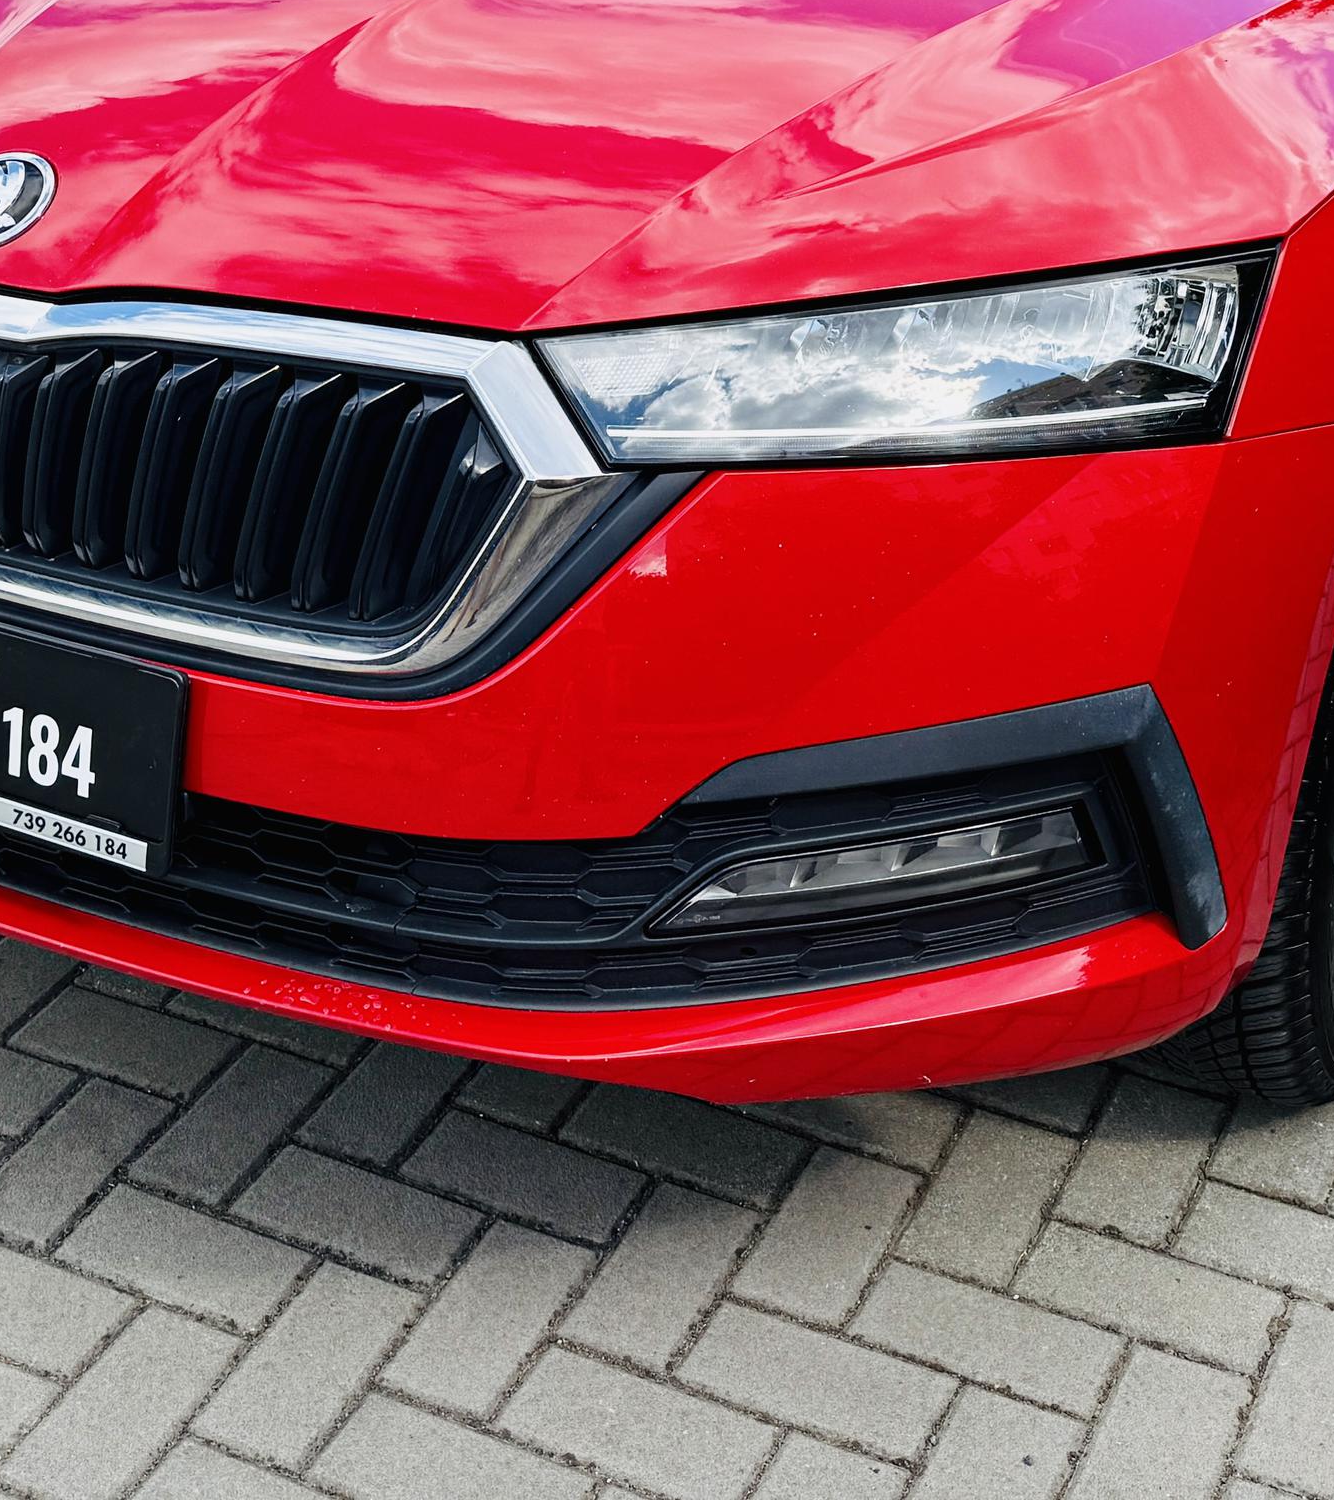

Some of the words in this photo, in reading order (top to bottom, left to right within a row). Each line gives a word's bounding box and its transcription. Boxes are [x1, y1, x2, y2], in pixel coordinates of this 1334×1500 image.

[2, 706, 96, 799] 184
[12, 808, 47, 834] 739
[52, 822, 87, 848] 266
[94, 834, 128, 861] 184
